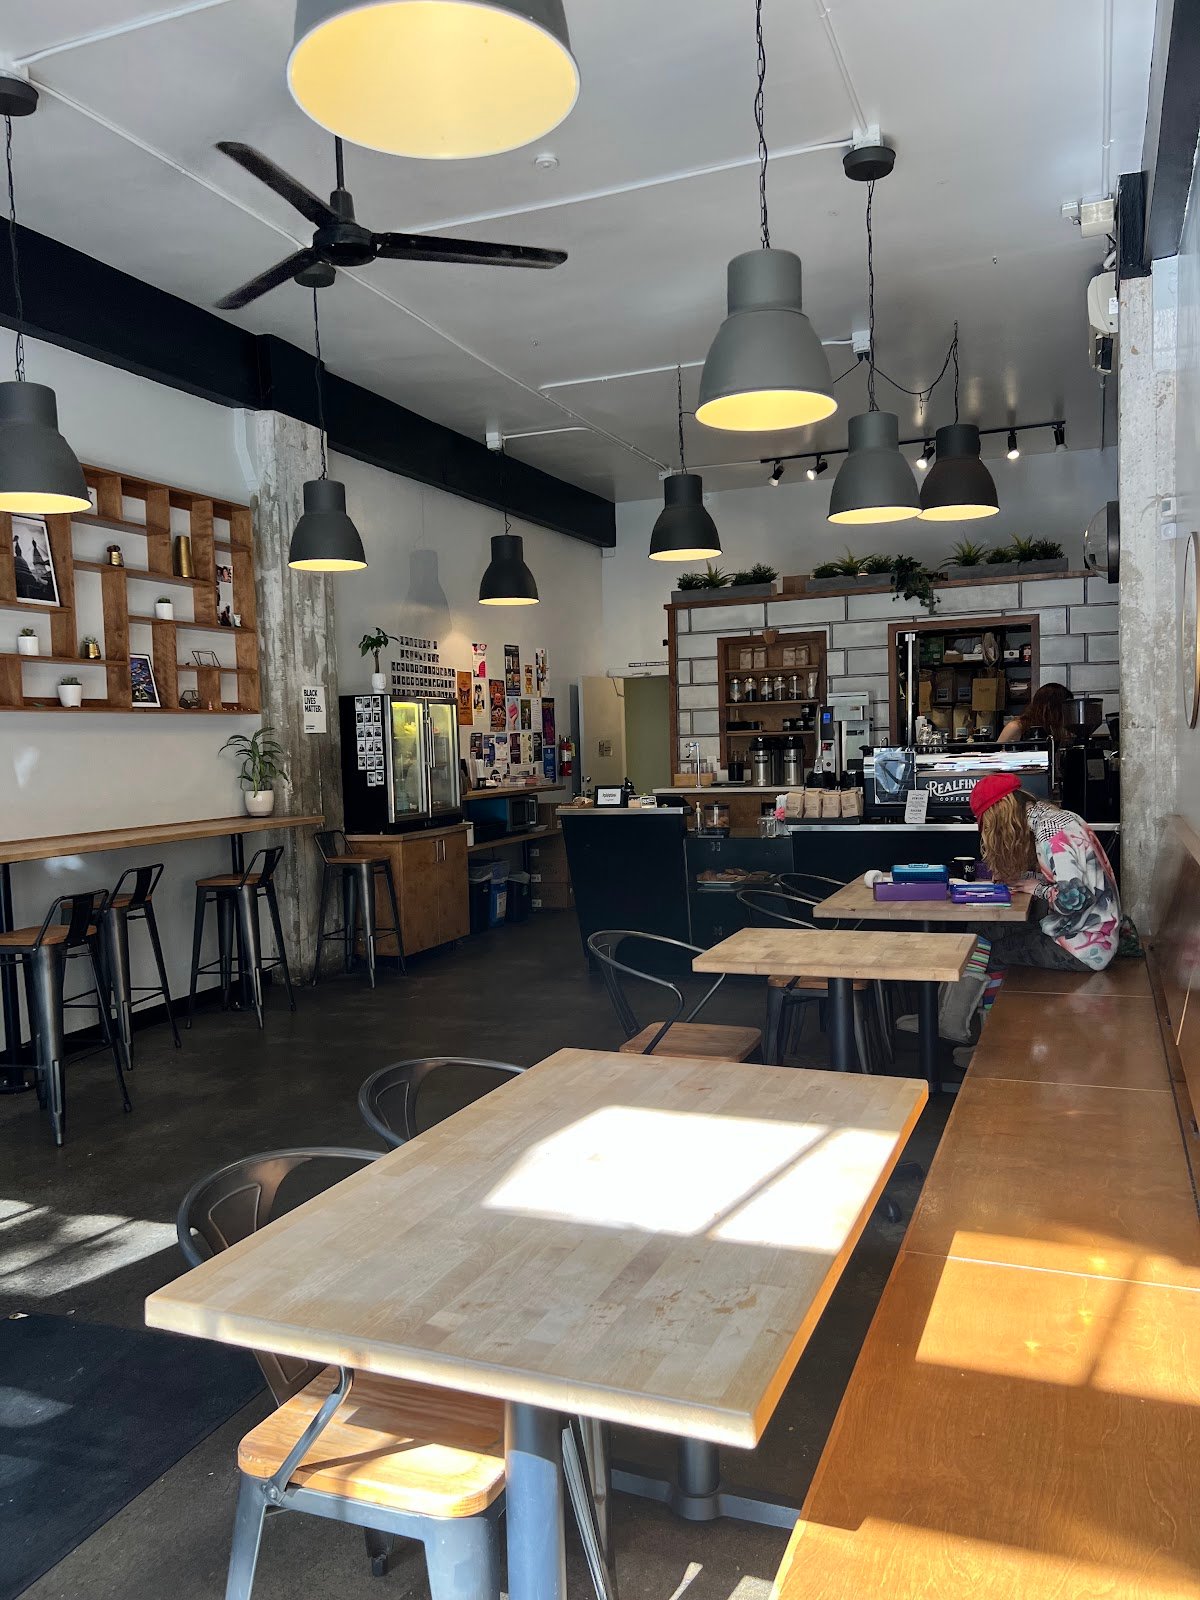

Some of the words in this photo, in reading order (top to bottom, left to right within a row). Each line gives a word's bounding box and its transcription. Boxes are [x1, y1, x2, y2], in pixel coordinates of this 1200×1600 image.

[304, 689, 317, 697] BLACK
[304, 705, 323, 713] MATTER.
[926, 779, 980, 798] REALFIN
